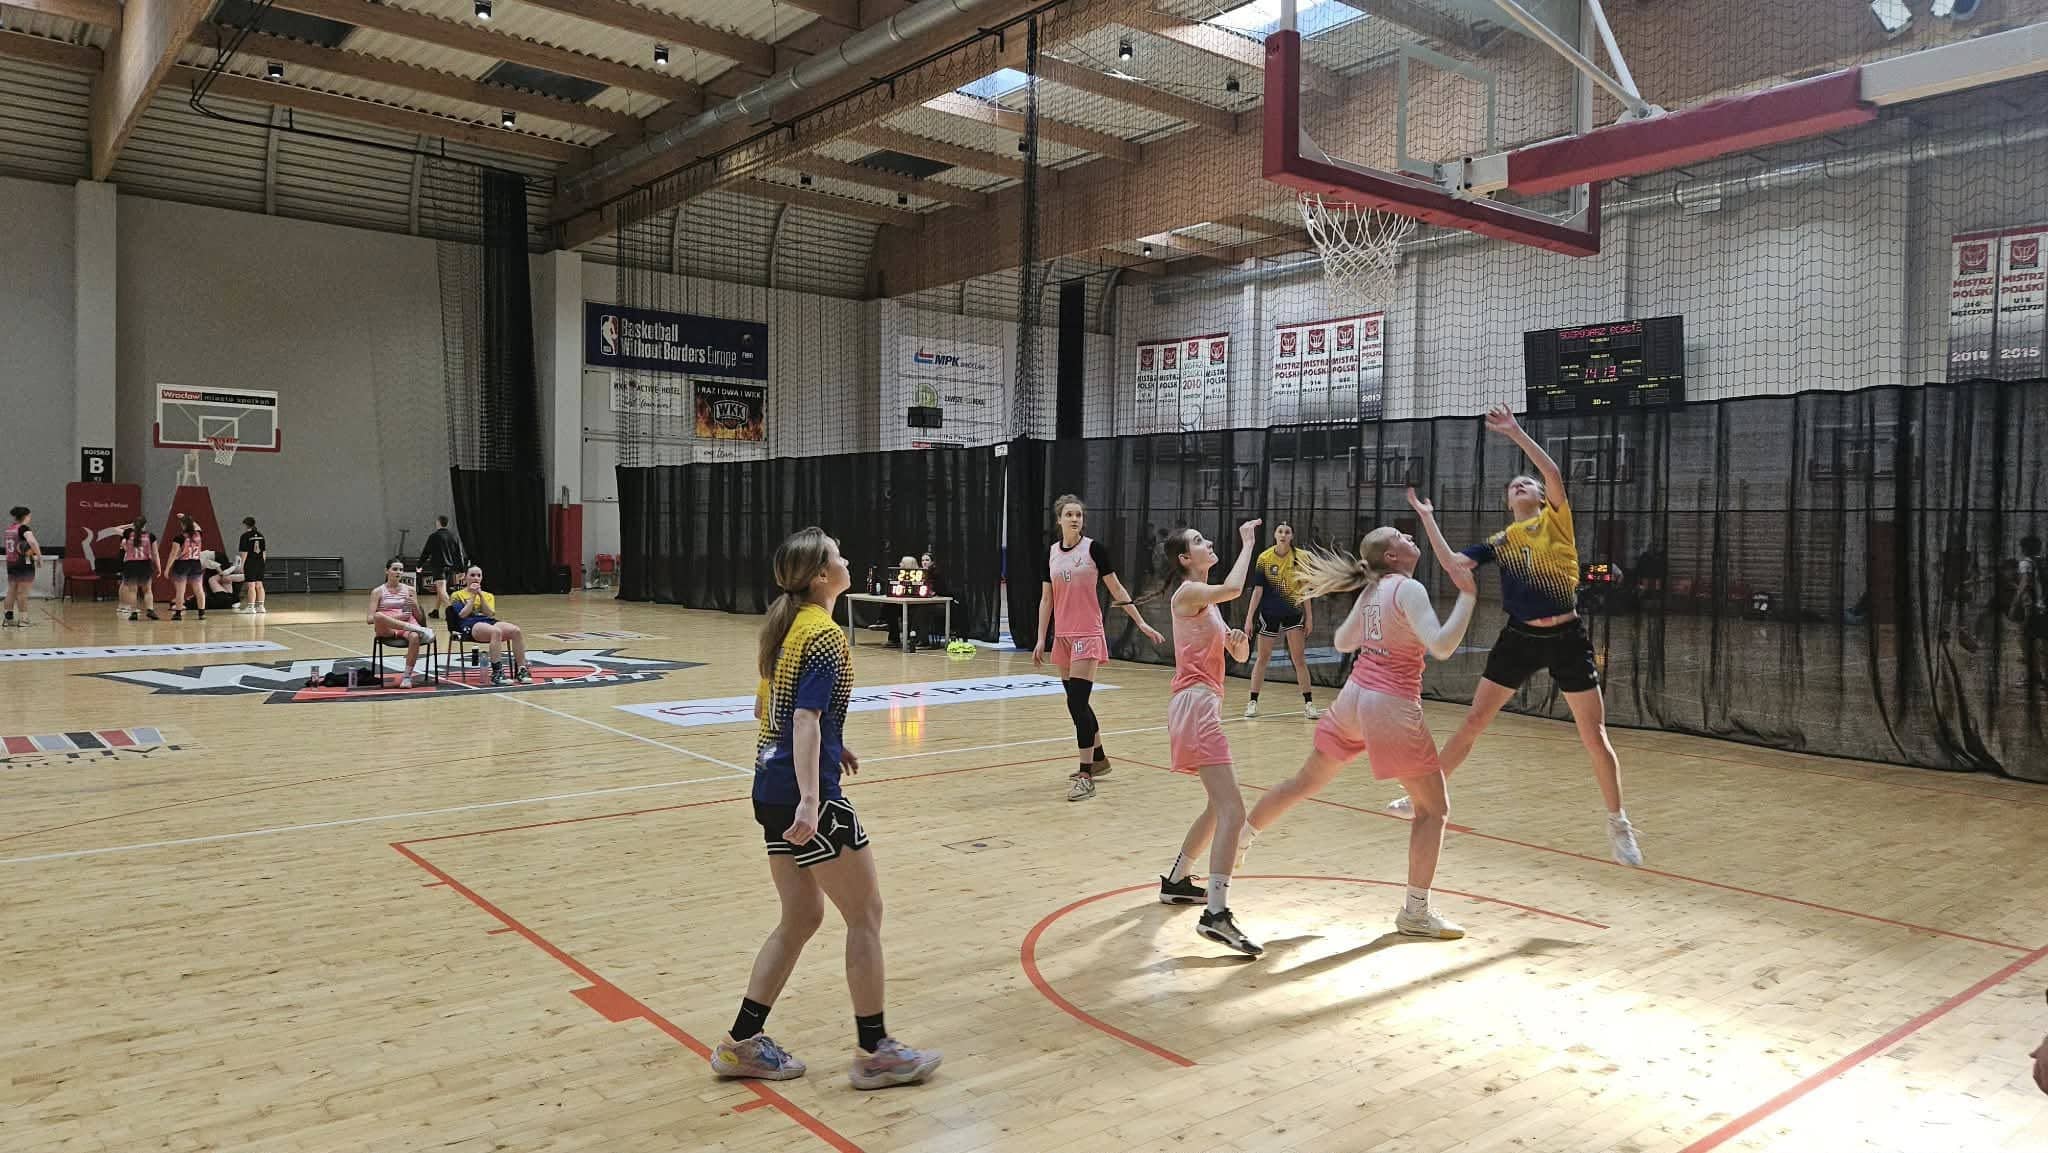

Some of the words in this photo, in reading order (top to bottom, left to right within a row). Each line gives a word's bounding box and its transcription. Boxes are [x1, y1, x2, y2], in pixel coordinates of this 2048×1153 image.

[1953, 277, 1993, 288] MISTRZ
[2001, 272, 2045, 283] MISTRZ
[1953, 288, 1993, 298] POLSKI
[2001, 282, 2045, 294] POLSKI
[622, 318, 679, 342] Basketball
[621, 337, 663, 359] Without
[664, 341, 706, 364] Borders
[707, 346, 737, 368] Europe
[1952, 351, 1989, 362] 2014
[2000, 347, 2040, 360] 2015
[934, 355, 960, 368] MPK
[661, 386, 681, 395] HOTEL
[744, 391, 761, 399] WKK
[717, 404, 744, 418] WKK
[89, 457, 105, 474] B
[1362, 605, 1383, 641] 13
[847, 691, 940, 704] ank
